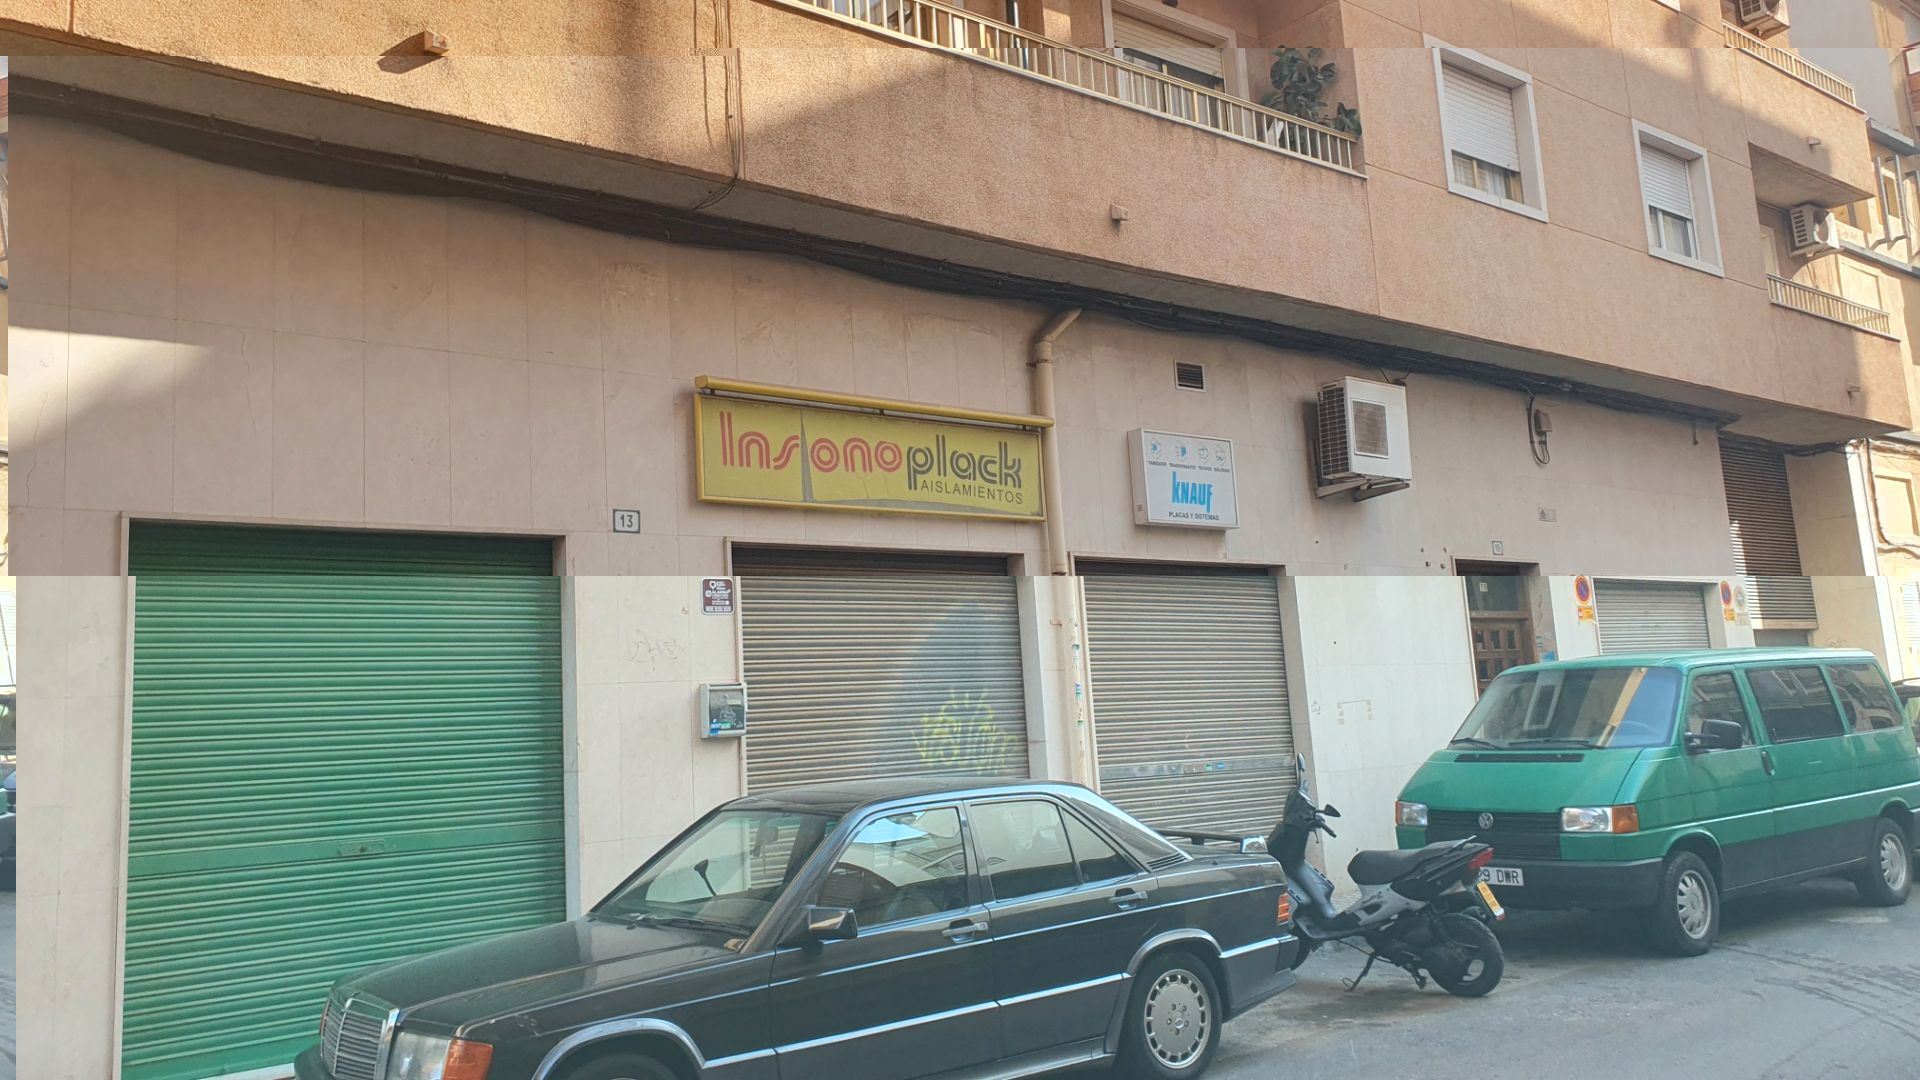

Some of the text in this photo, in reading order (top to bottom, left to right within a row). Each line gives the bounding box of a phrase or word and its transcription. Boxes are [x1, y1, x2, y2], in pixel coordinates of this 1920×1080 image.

[920, 479, 1024, 505] AISLAMIENTOS
[620, 514, 633, 528] 13
[1168, 511, 1190, 519] PLACAS
[1496, 869, 1520, 884] DWR
